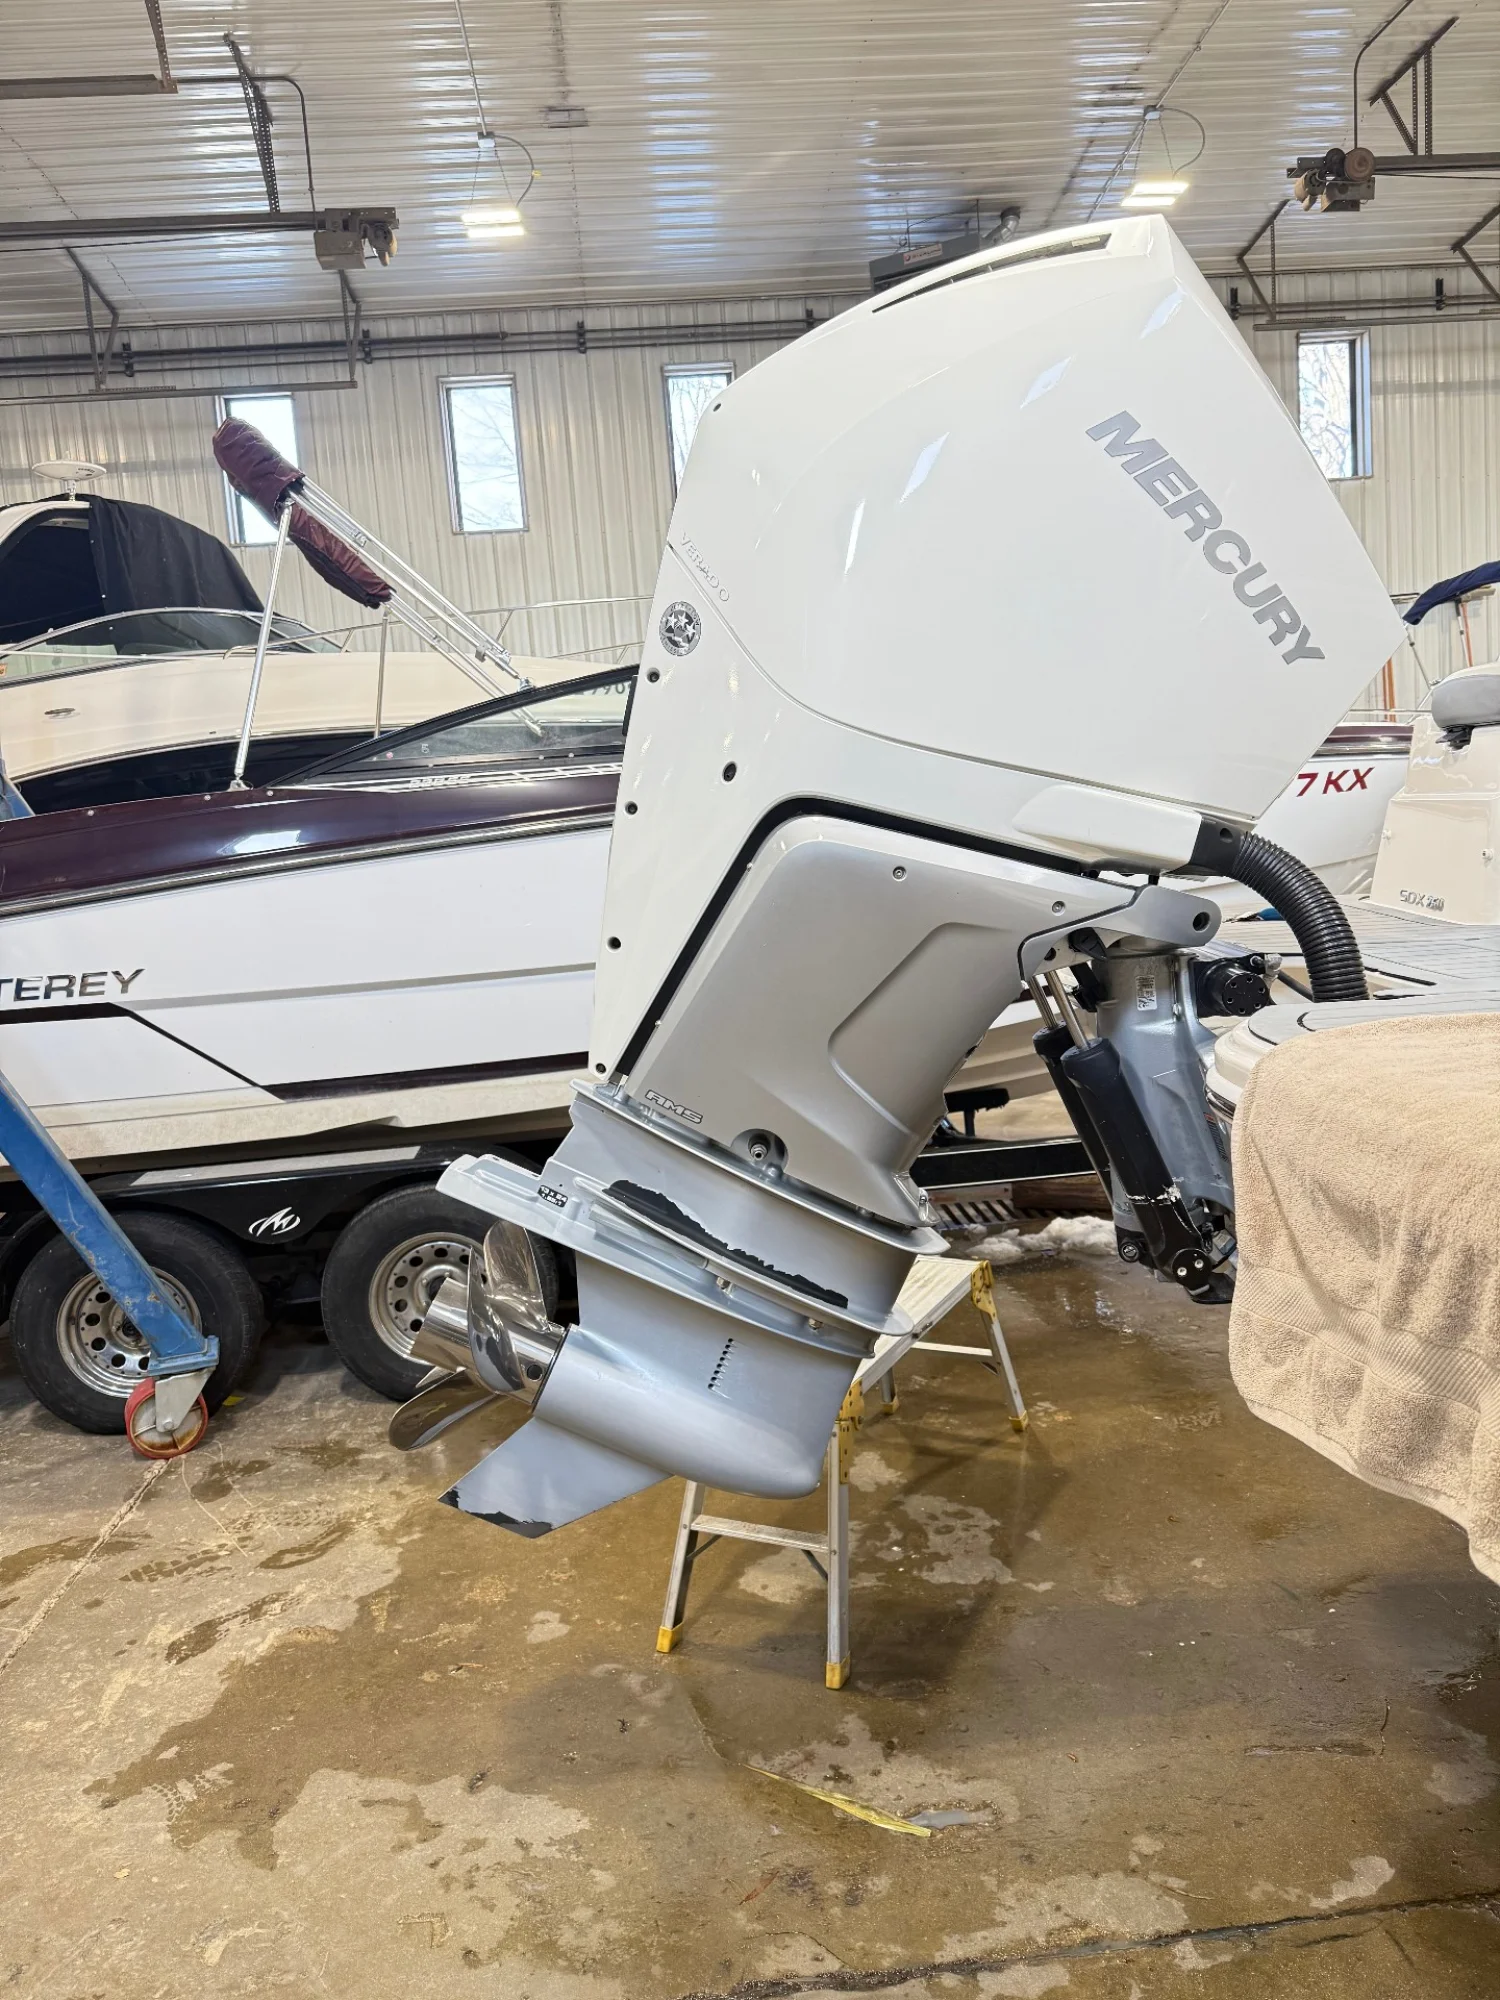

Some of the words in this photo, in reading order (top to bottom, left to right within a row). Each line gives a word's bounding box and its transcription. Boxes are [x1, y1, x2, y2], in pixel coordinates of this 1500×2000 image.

[1085, 410, 1326, 666] MERCURY
[680, 532, 730, 602] VERADO
[1322, 766, 1376, 795] KX
[645, 1089, 704, 1125] AMS
